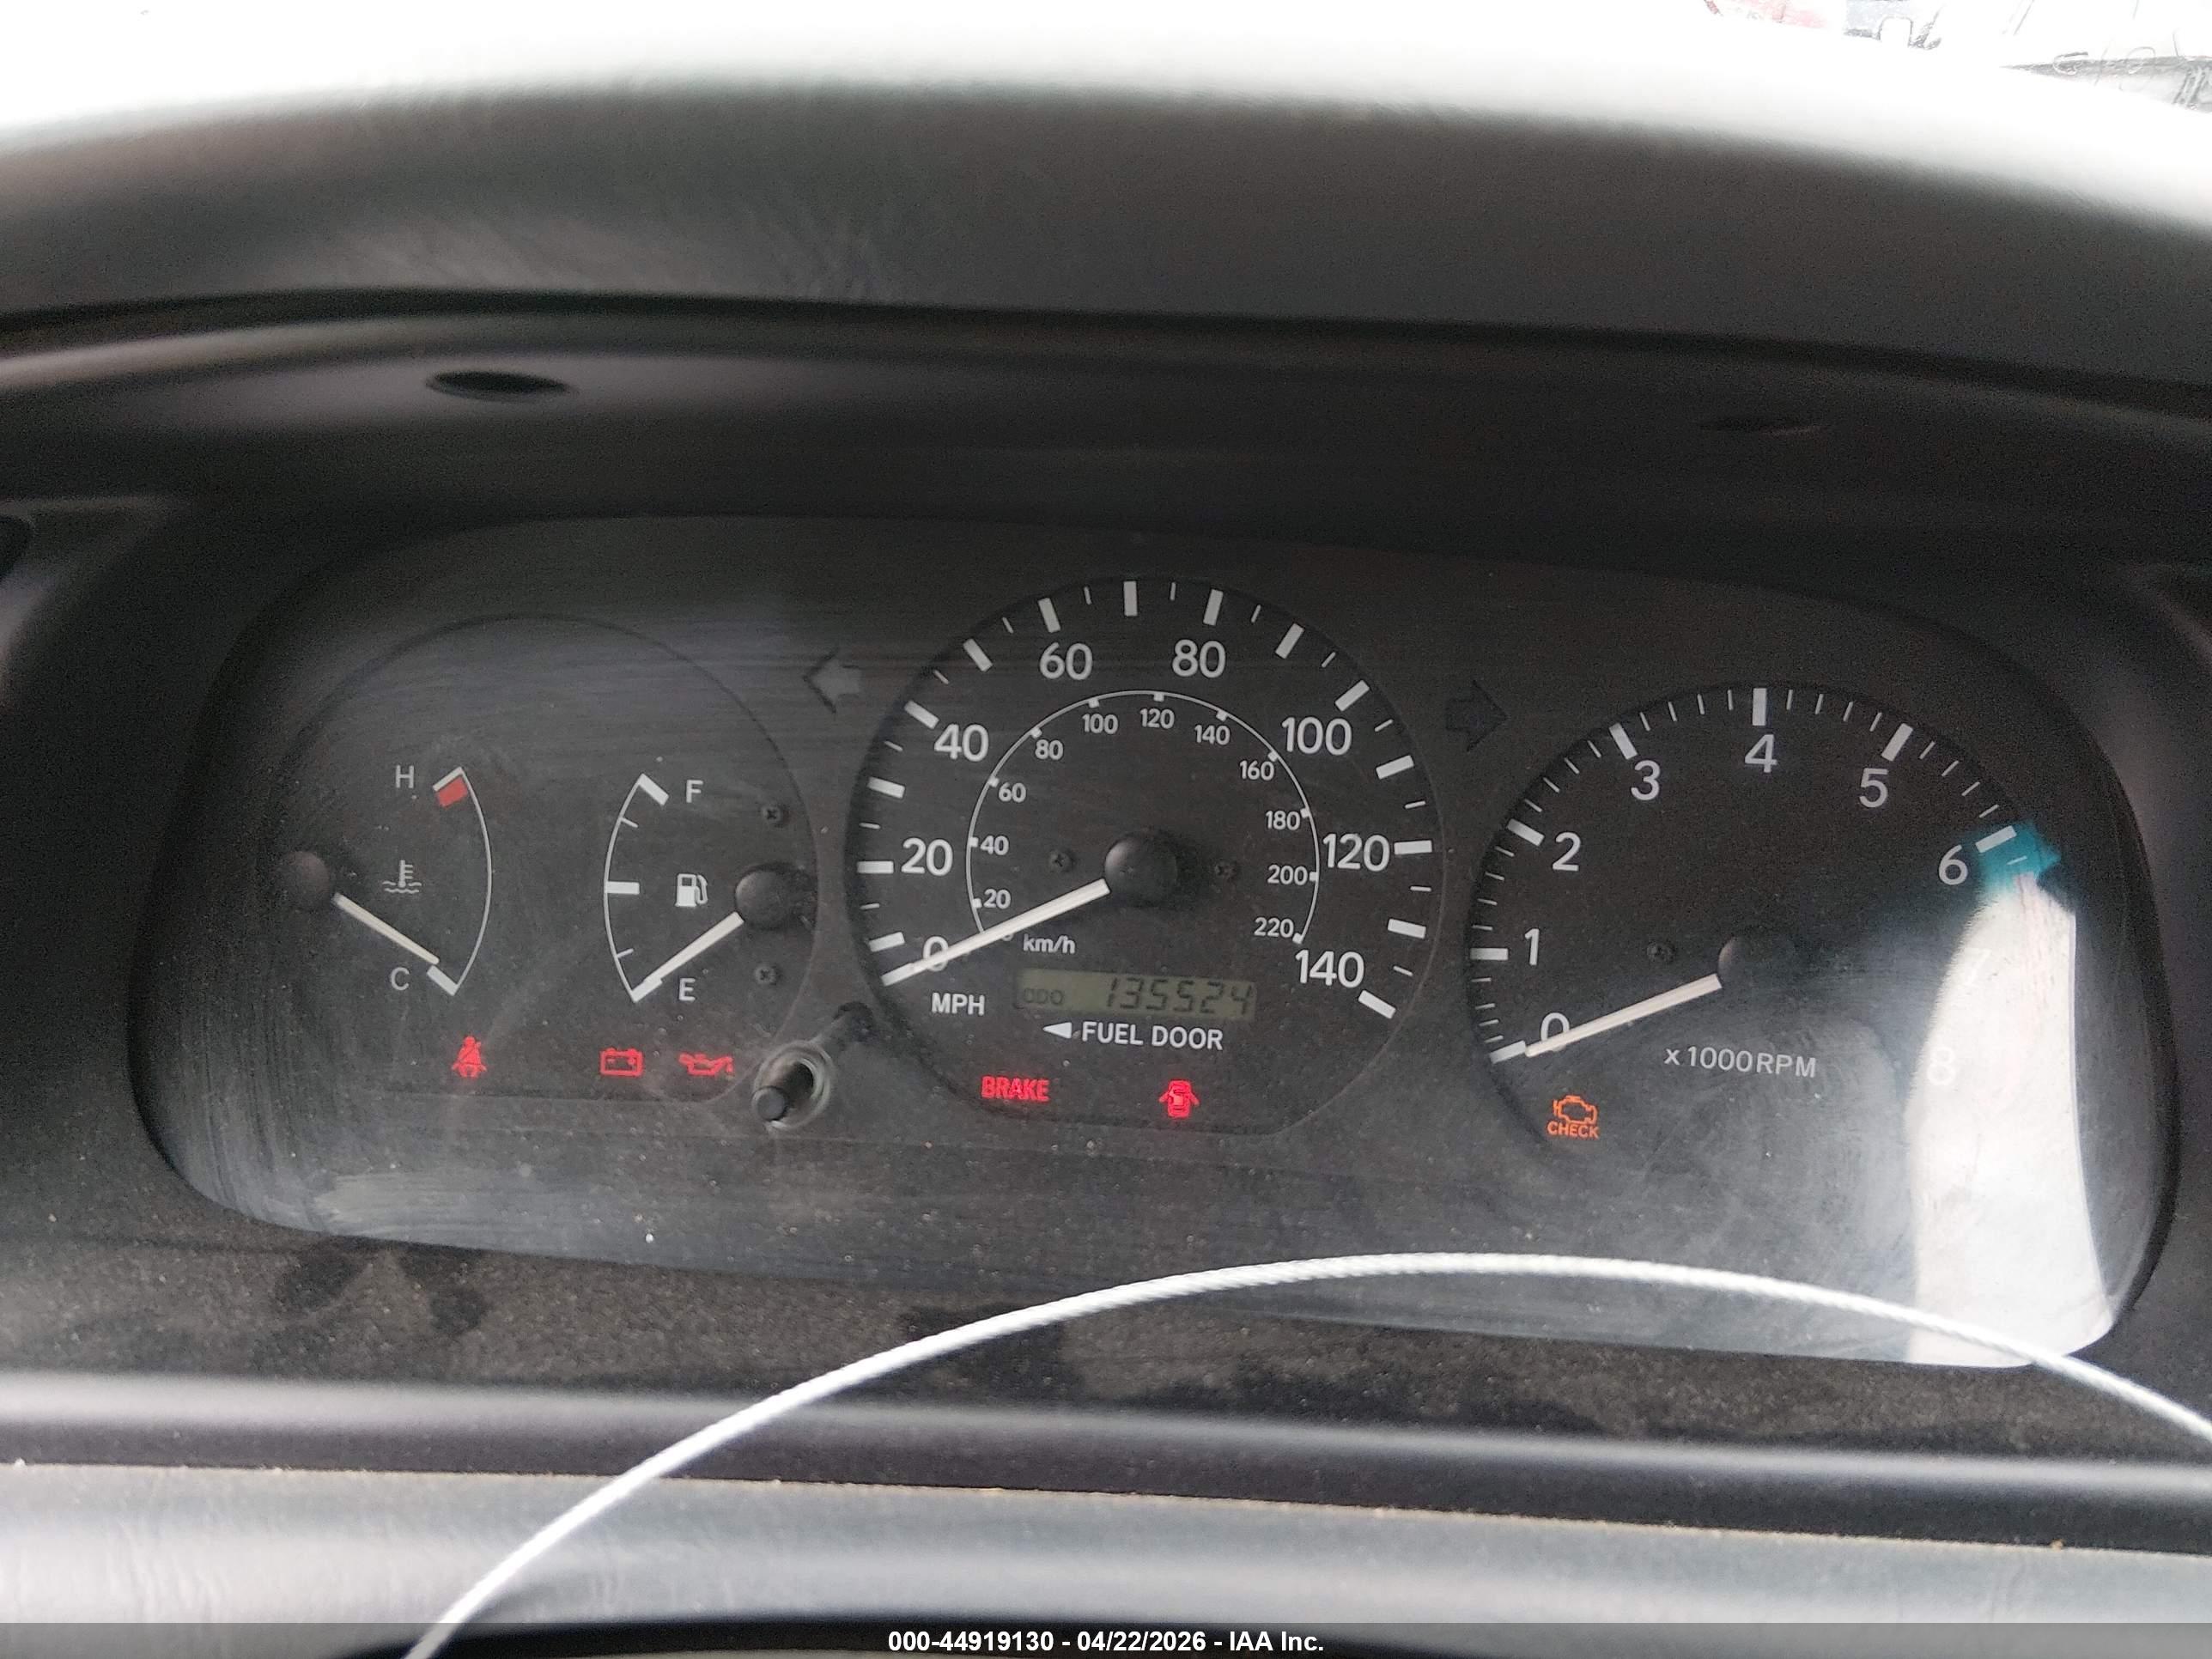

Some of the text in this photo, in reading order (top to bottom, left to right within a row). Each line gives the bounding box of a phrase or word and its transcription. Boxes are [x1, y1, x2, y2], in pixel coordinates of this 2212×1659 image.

[1038, 642, 1093, 680] 60
[1171, 638, 1226, 678] 80
[1082, 714, 1118, 735] 100
[1139, 708, 1175, 730] 120
[933, 723, 989, 762] 40
[1194, 723, 1231, 746] 140
[1280, 716, 1352, 756] 100
[1035, 739, 1064, 762] 80
[1744, 733, 1778, 773] 4
[394, 765, 415, 790] H
[1239, 760, 1275, 781] 160
[1631, 759, 1662, 801] 3
[686, 779, 704, 804] F
[998, 782, 1027, 804] 60
[1858, 767, 1889, 808] 5
[1264, 809, 1301, 831] 180
[901, 837, 954, 877] 20
[979, 836, 1009, 856] 40
[1322, 833, 1390, 872] 120
[1552, 831, 1582, 872] 2
[1267, 865, 1308, 886] 200
[1937, 844, 1970, 886] 6
[983, 889, 1012, 910] 20
[1254, 917, 1294, 939] 220
[922, 935, 950, 972] 0
[1023, 933, 1077, 955] km/h
[1523, 928, 1540, 967] 1
[390, 967, 410, 991] C
[1294, 949, 1364, 988] 140
[678, 977, 696, 1002] E
[1105, 975, 1254, 1016] 135524
[931, 991, 986, 1016] MPH
[1081, 1020, 1224, 1051] FUEL DOOR
[1926, 1046, 1956, 1087] 8
[981, 1074, 1050, 1103] BRAKE
[1547, 1120, 1600, 1139] CHECK
